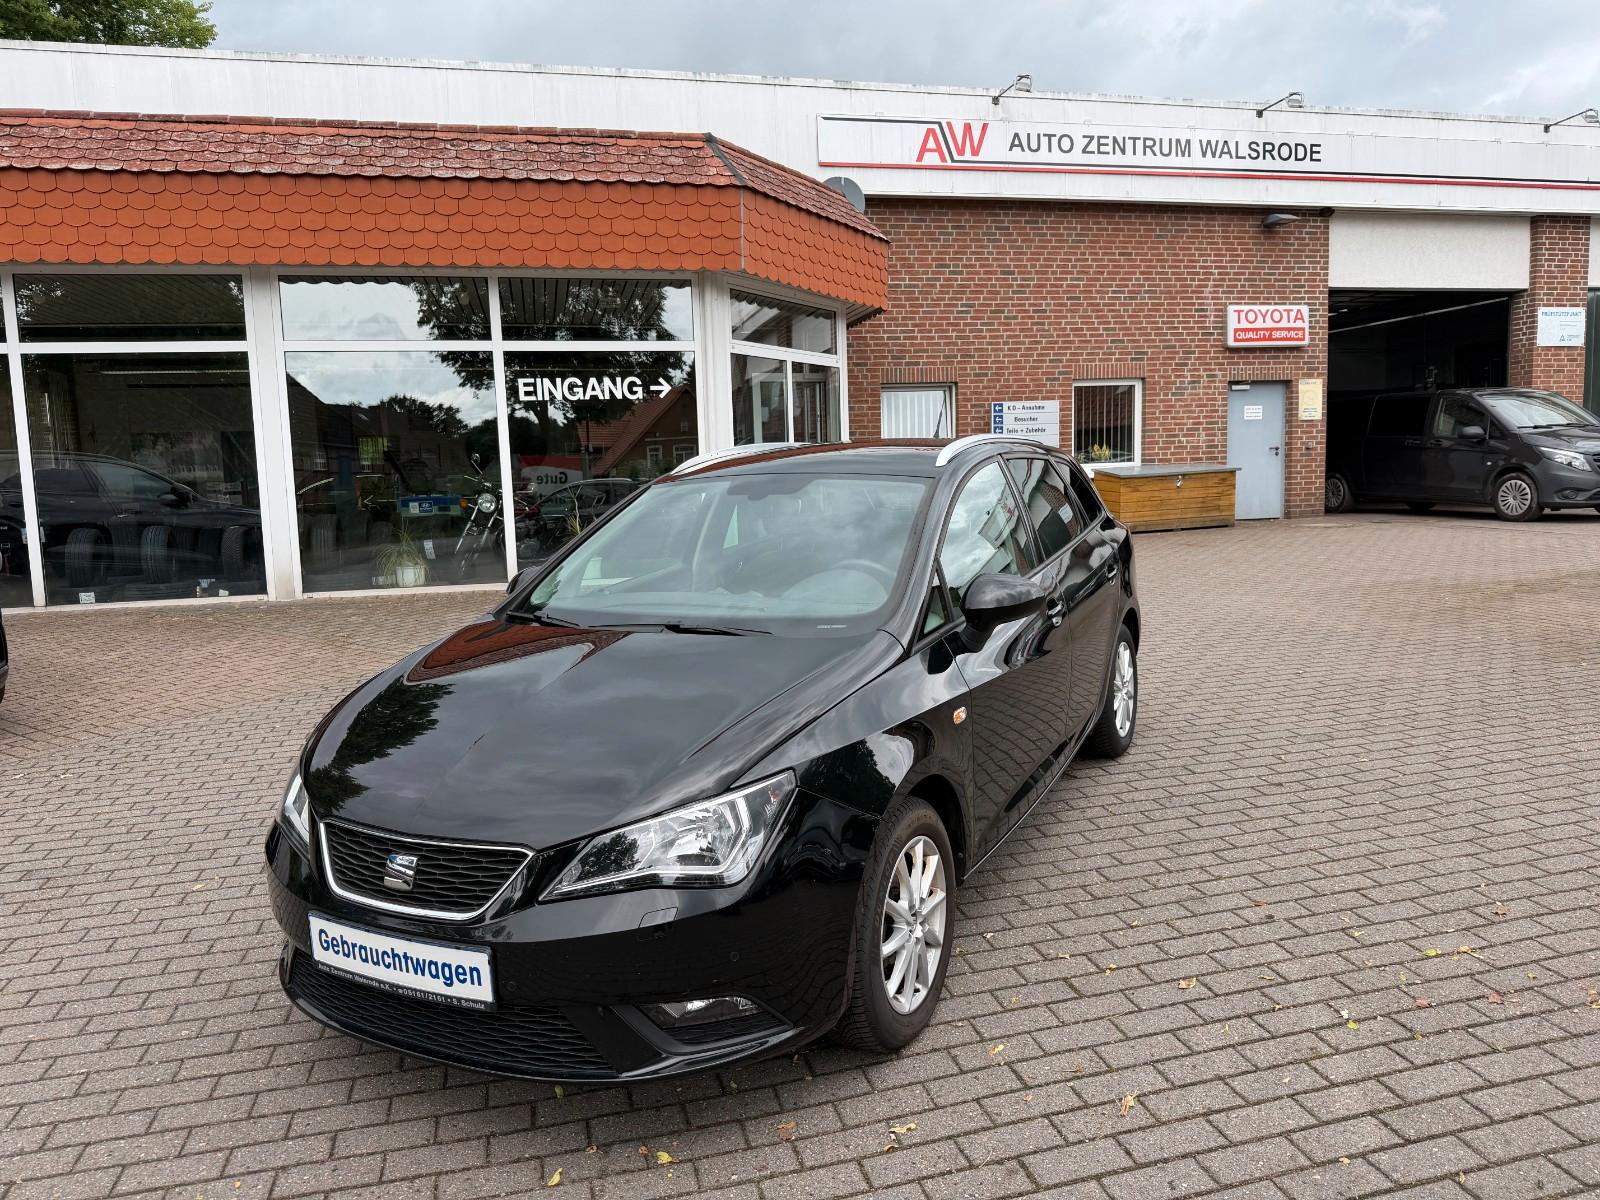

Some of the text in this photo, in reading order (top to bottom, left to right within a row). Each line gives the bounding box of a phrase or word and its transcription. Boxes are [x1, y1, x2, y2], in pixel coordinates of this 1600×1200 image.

[1008, 132, 1074, 154] AUTO
[1081, 135, 1191, 158] ZENTRUM
[1199, 140, 1322, 162] WALSRODE
[1233, 309, 1305, 324] TOYOTA
[1236, 330, 1304, 339] QUALITY SERVICE
[518, 377, 643, 400] EINGANG
[318, 928, 482, 987] Gebrauchtwagen
